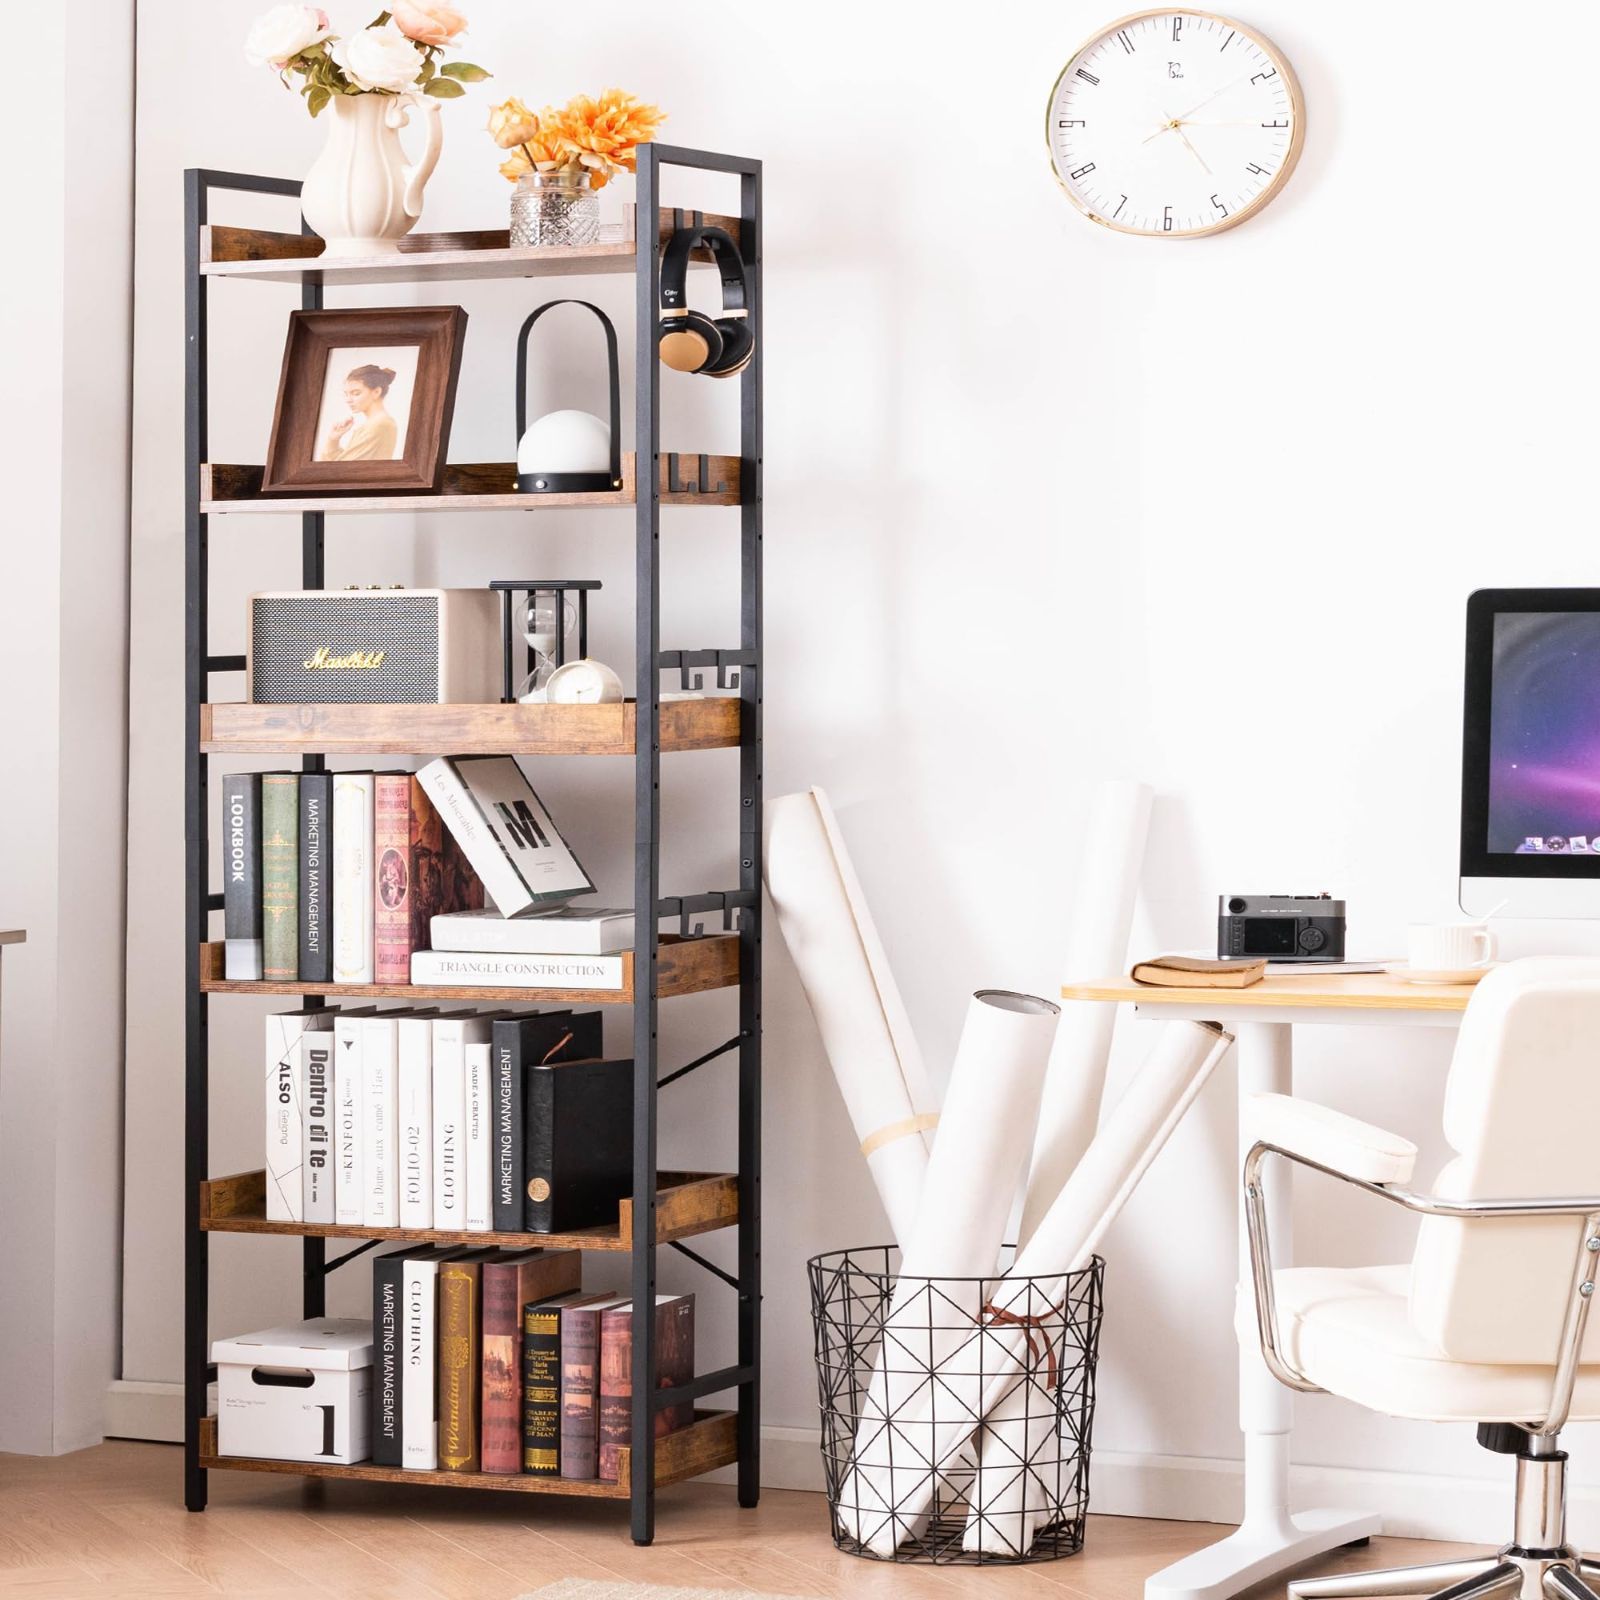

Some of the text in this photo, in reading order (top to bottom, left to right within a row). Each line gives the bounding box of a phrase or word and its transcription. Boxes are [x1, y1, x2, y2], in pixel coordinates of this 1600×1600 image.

[1117, 30, 1135, 55] 11
[1172, 17, 1182, 42] 12
[1220, 31, 1235, 52] 1
[1250, 67, 1277, 85] 2
[1058, 120, 1086, 128] 9
[1261, 119, 1289, 128] 3
[1071, 162, 1096, 180] 8
[1245, 162, 1272, 176] 4
[1113, 194, 1128, 218] 7
[1163, 206, 1173, 231] 6
[1210, 194, 1228, 218] 5
[230, 794, 245, 883] LOOKBOOK
[493, 800, 552, 850] M
[308, 799, 319, 954] MARKETING MANAGEMENT
[439, 961, 606, 976] TRIANGLE CONSTRUCTION
[279, 1061, 291, 1104] ALSO
[472, 1092, 478, 1100] &
[309, 1049, 329, 1168] Dentro di te
[471, 1100, 479, 1140] CRAFTED
[343, 1098, 353, 1169] KINFOLK
[500, 1047, 512, 1205] MARKETING MANAGEMENT
[407, 1125, 421, 1204] FOLIO-02
[443, 1124, 455, 1210] CLOTHING
[373, 1166, 385, 1196] Dame
[373, 1201, 385, 1216] La
[410, 1280, 422, 1366] CLOTHING
[383, 1283, 394, 1439] MARKETING MANAGEMENT
[314, 1405, 343, 1457] 1
